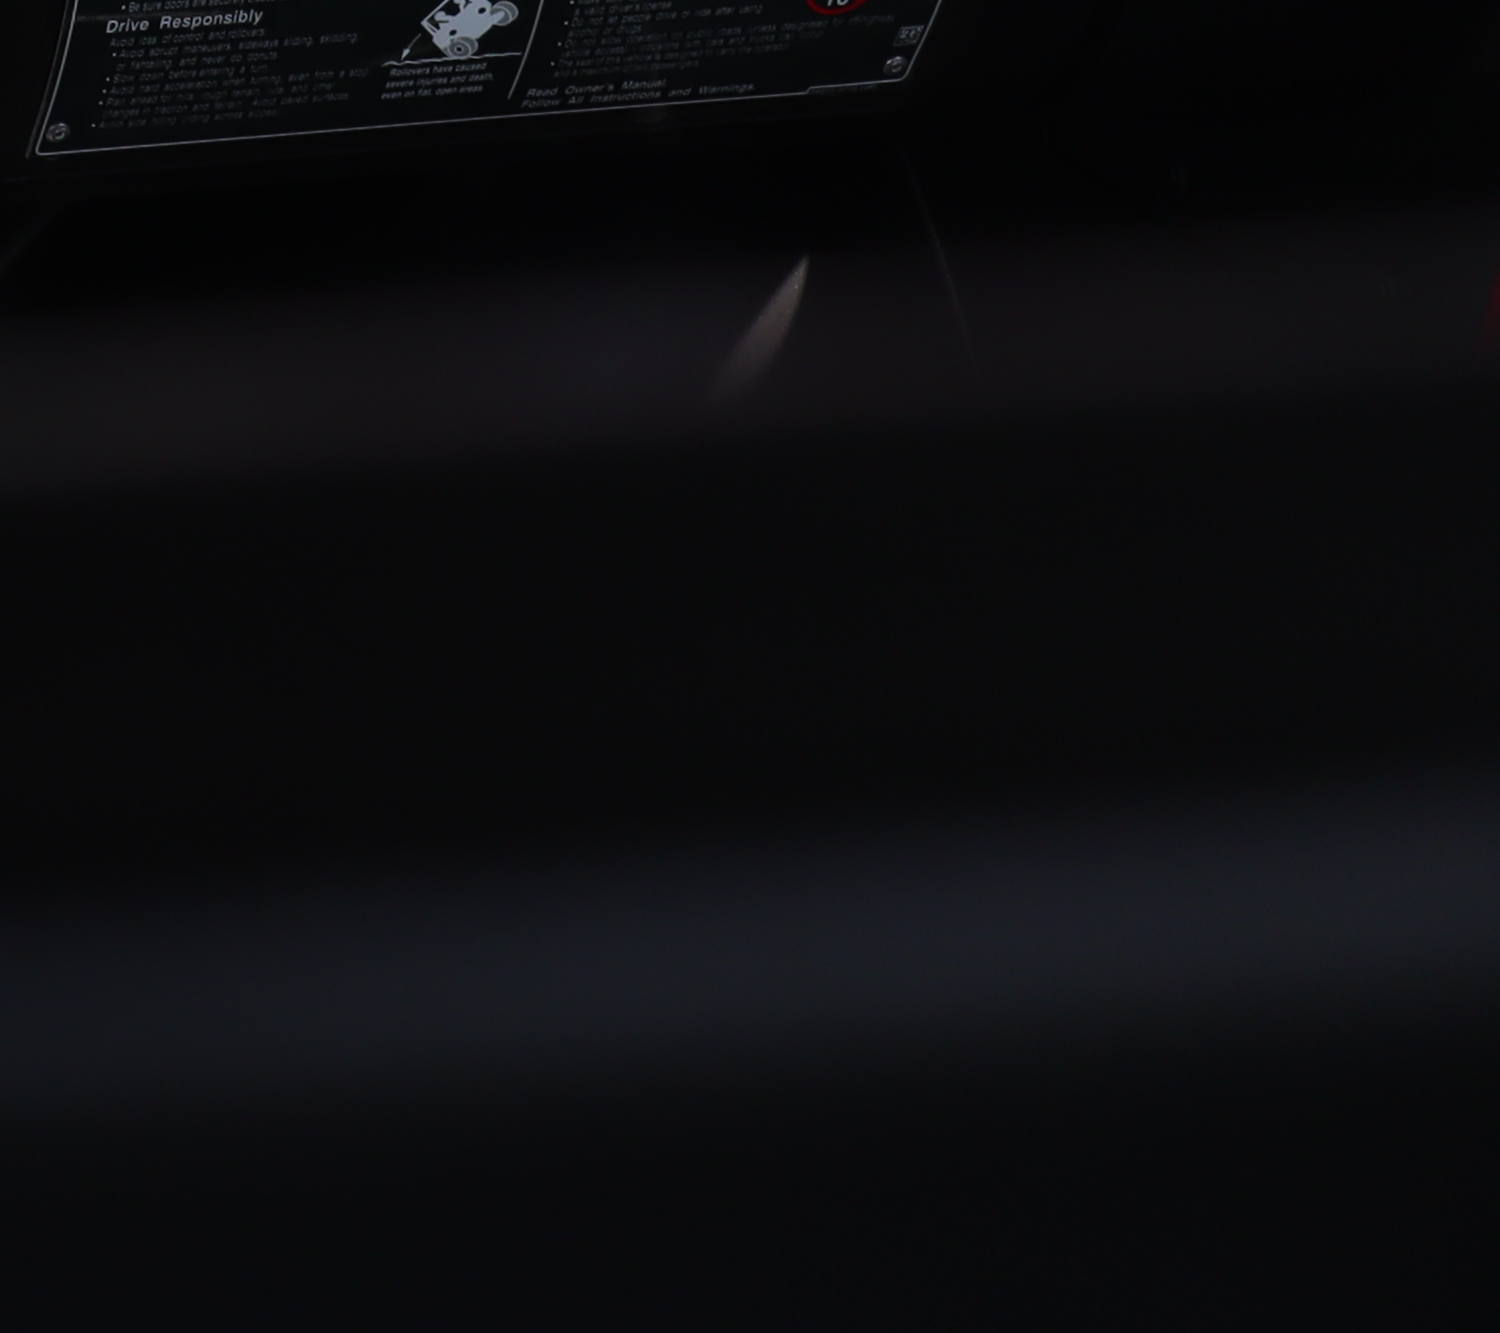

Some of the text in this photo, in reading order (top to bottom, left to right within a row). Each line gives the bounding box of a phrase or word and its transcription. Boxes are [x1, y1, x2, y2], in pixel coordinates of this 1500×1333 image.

[106, 9, 264, 35] Drive Responsibly
[520, 96, 561, 110] Follow
[567, 94, 584, 105] All
[589, 89, 663, 104] Instructions
[668, 87, 691, 98] and
[525, 86, 558, 99] Read
[564, 82, 615, 95] Owner's
